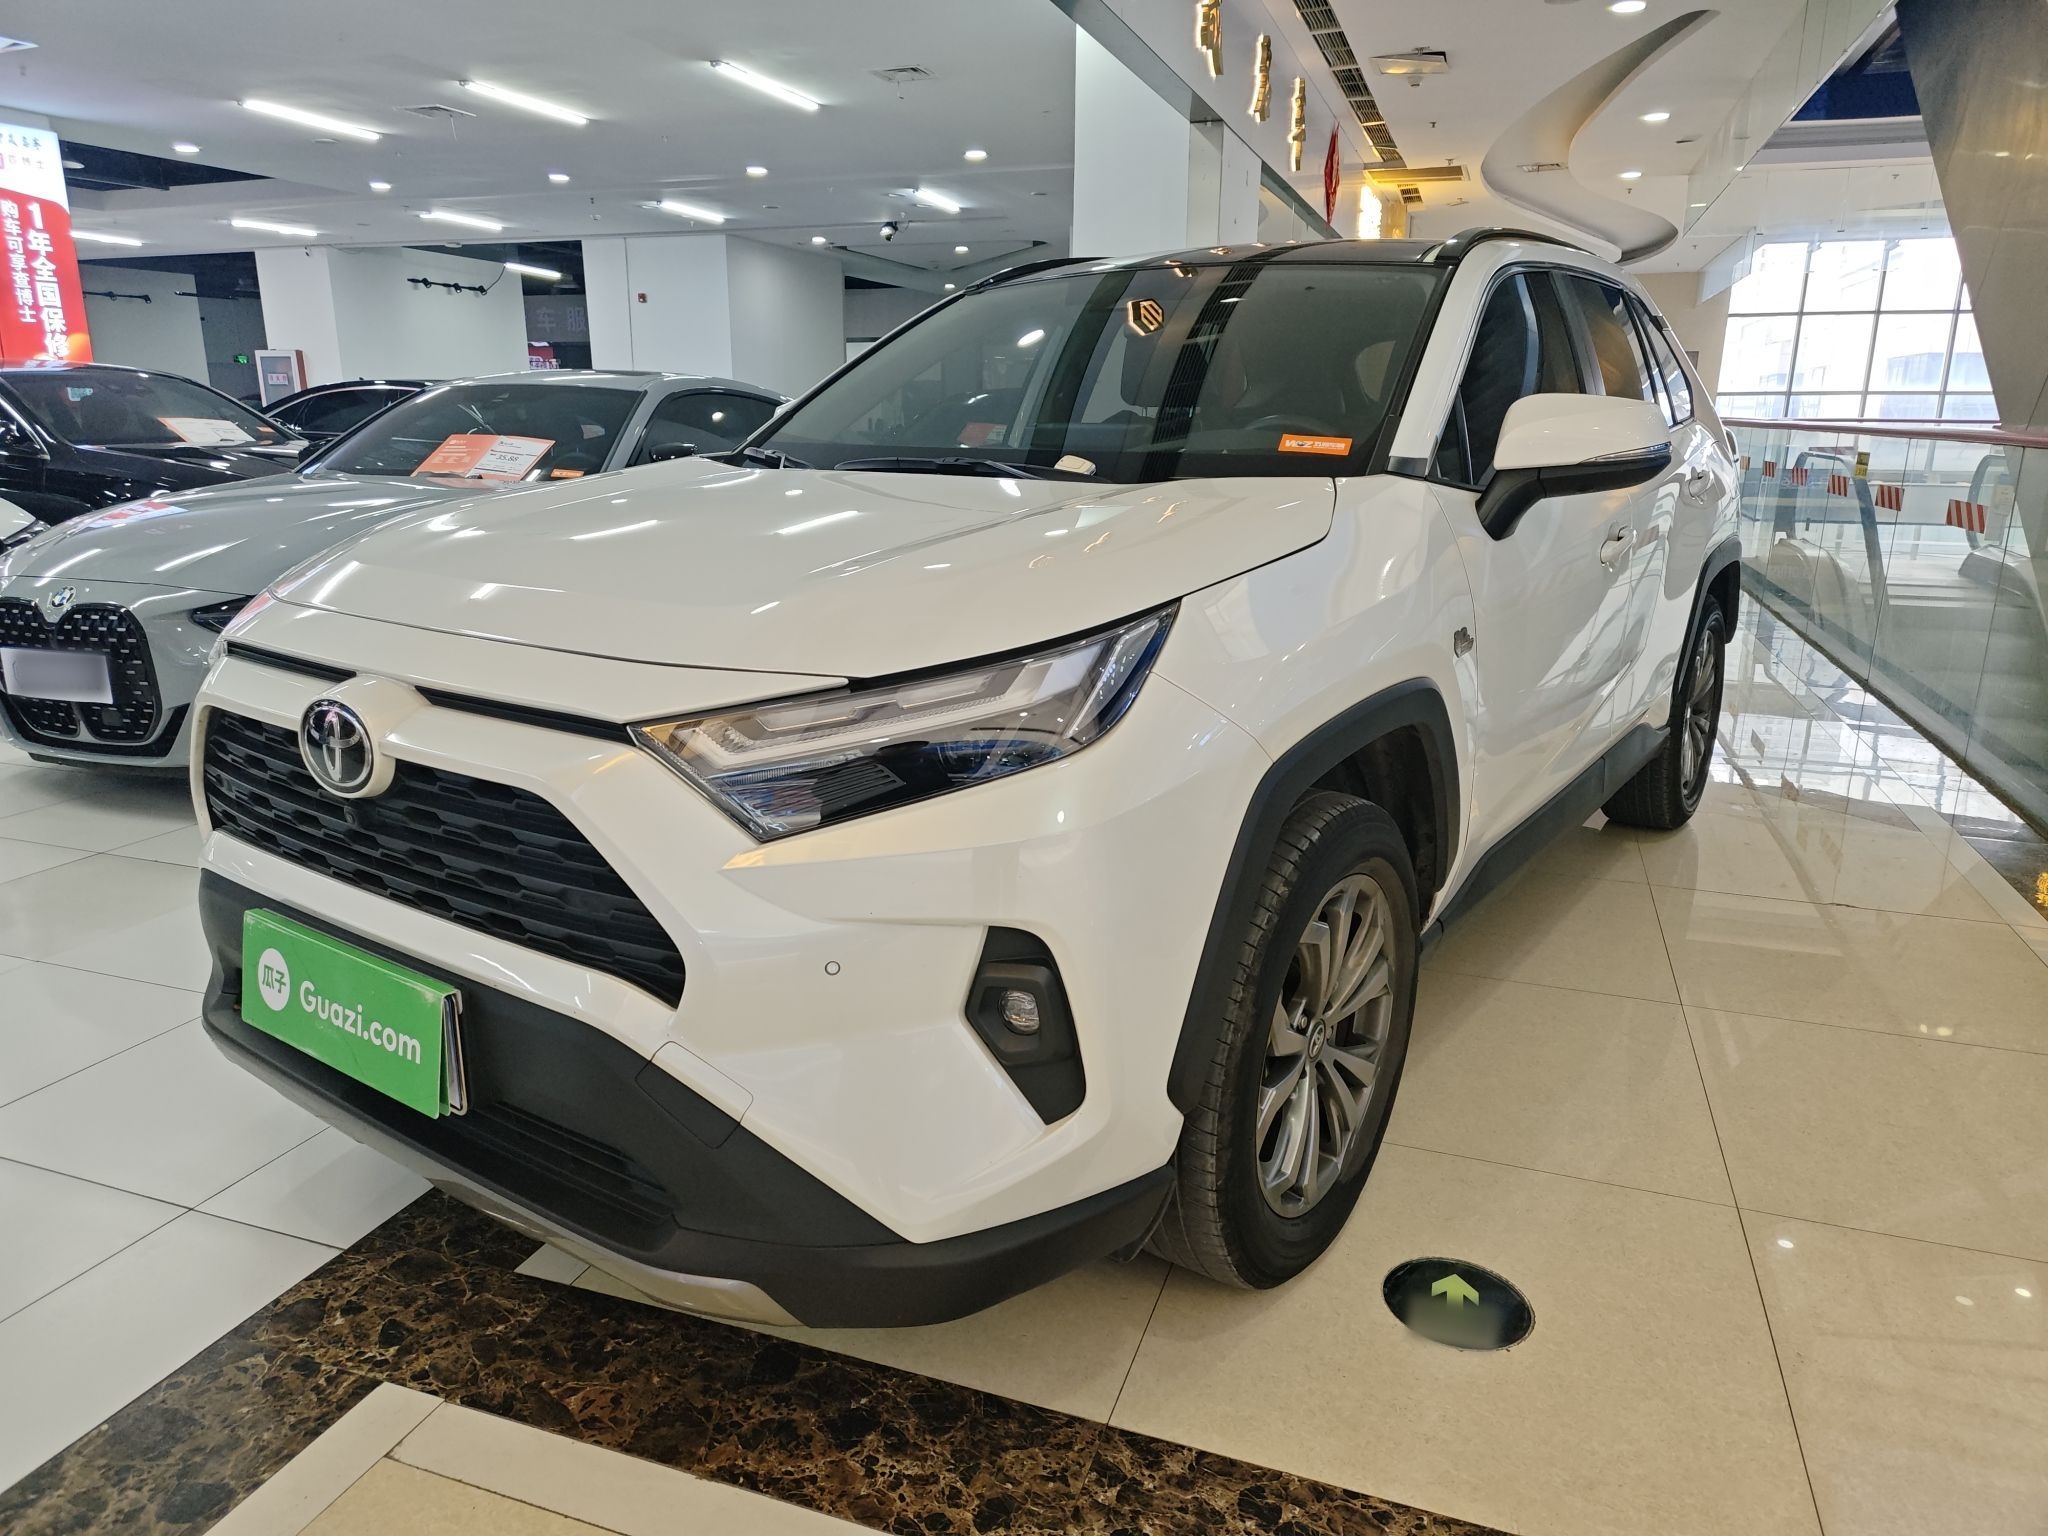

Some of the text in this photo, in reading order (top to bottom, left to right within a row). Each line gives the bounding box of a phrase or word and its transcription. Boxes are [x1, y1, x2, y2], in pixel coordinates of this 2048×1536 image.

[27, 202, 69, 359] 1年全国保修
[261, 964, 287, 994] 瓜子
[300, 980, 421, 1065] Guazi.com
